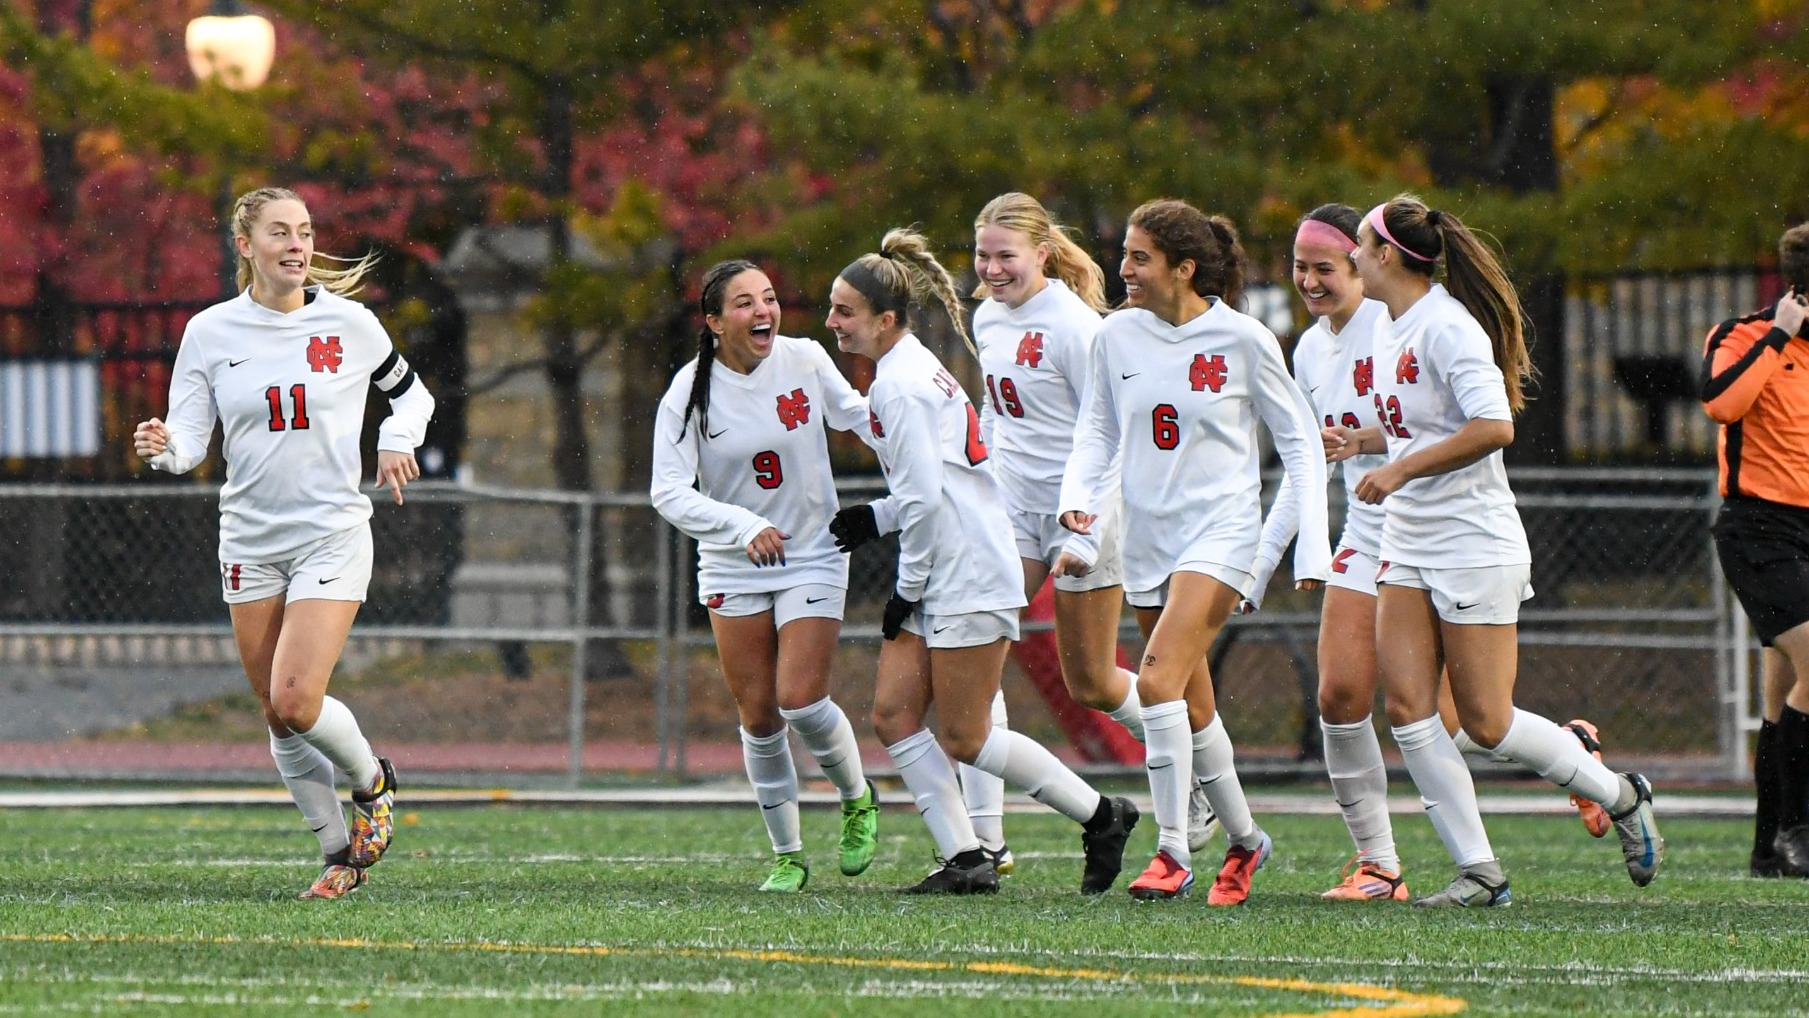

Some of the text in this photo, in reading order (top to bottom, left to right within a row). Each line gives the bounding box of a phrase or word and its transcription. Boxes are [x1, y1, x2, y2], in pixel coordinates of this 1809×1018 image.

[306, 336, 343, 373] NC
[1188, 353, 1228, 393] NC
[265, 383, 310, 432] 11
[776, 387, 811, 432] NC
[986, 374, 1024, 418] 19
[1374, 393, 1413, 439] 22
[1152, 403, 1180, 450] 6
[752, 450, 783, 490] 9
